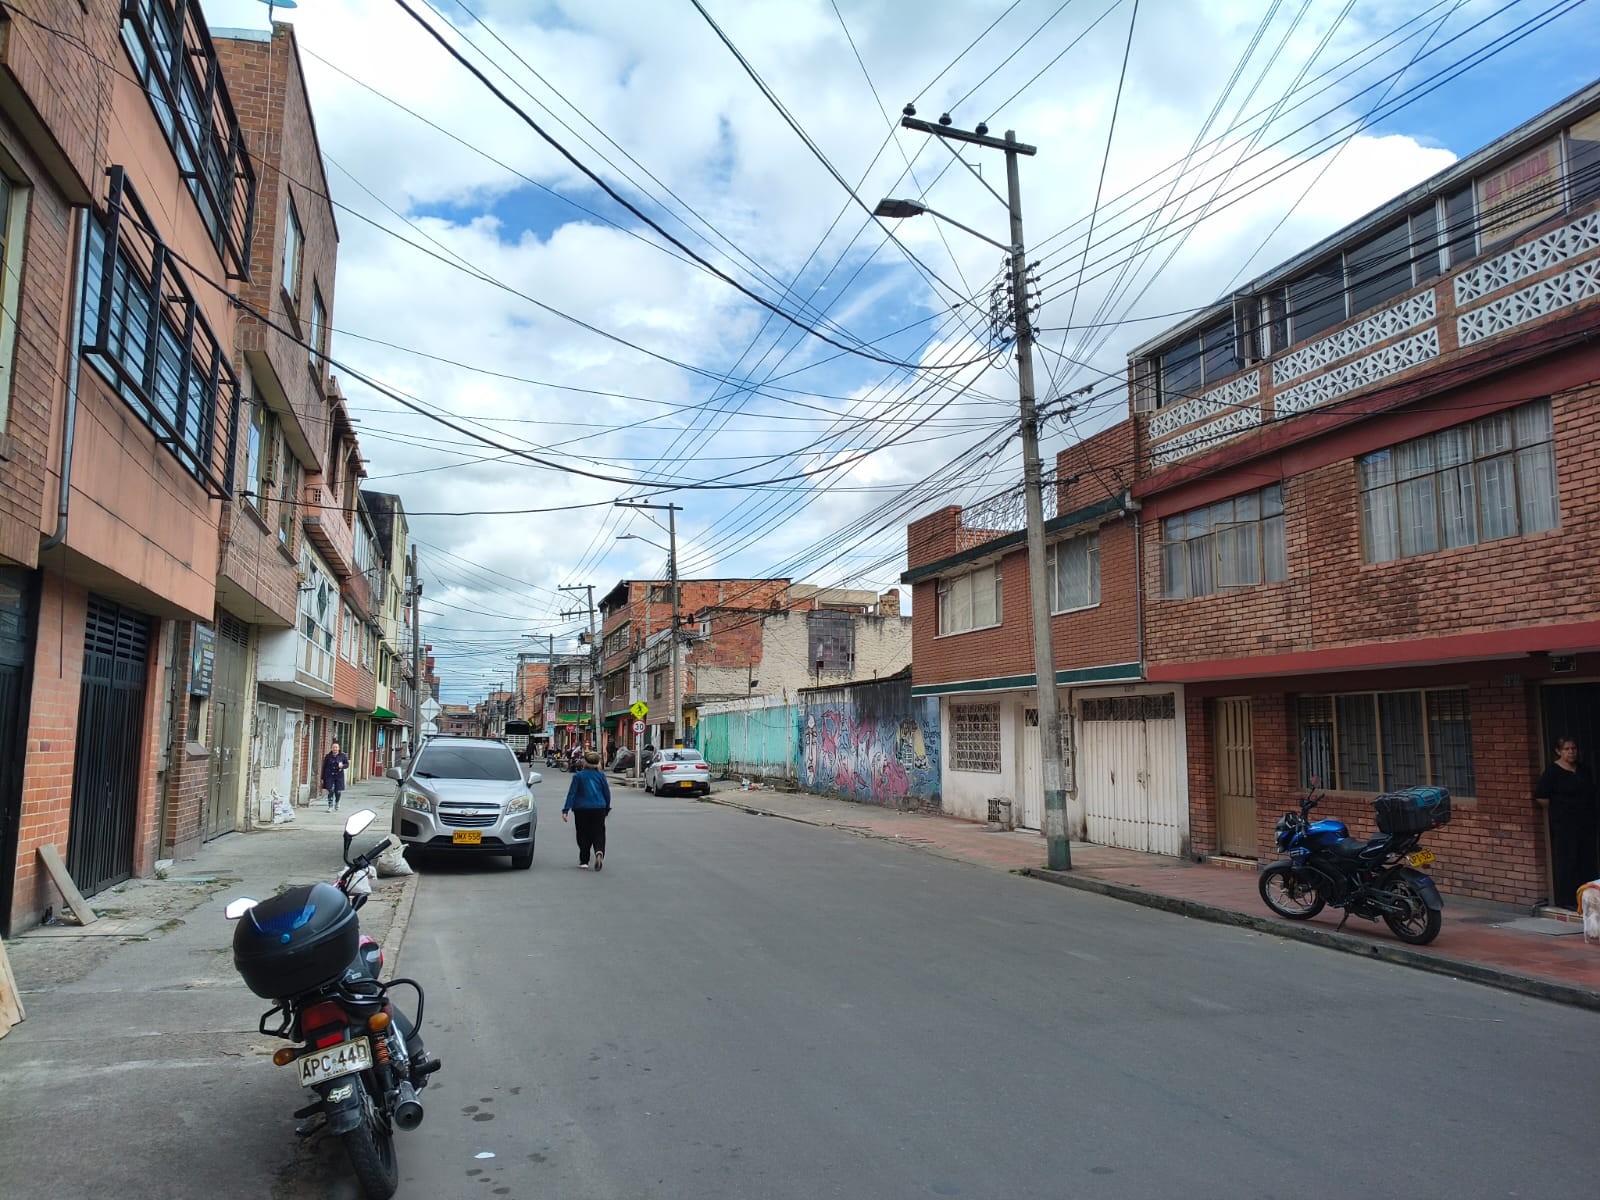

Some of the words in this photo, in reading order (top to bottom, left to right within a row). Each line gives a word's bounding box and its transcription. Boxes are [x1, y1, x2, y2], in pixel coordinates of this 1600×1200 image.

[1485, 176, 1502, 205] SE
[1504, 149, 1550, 194] VENDE
[635, 723, 644, 731] 30
[302, 1055, 331, 1079] APC
